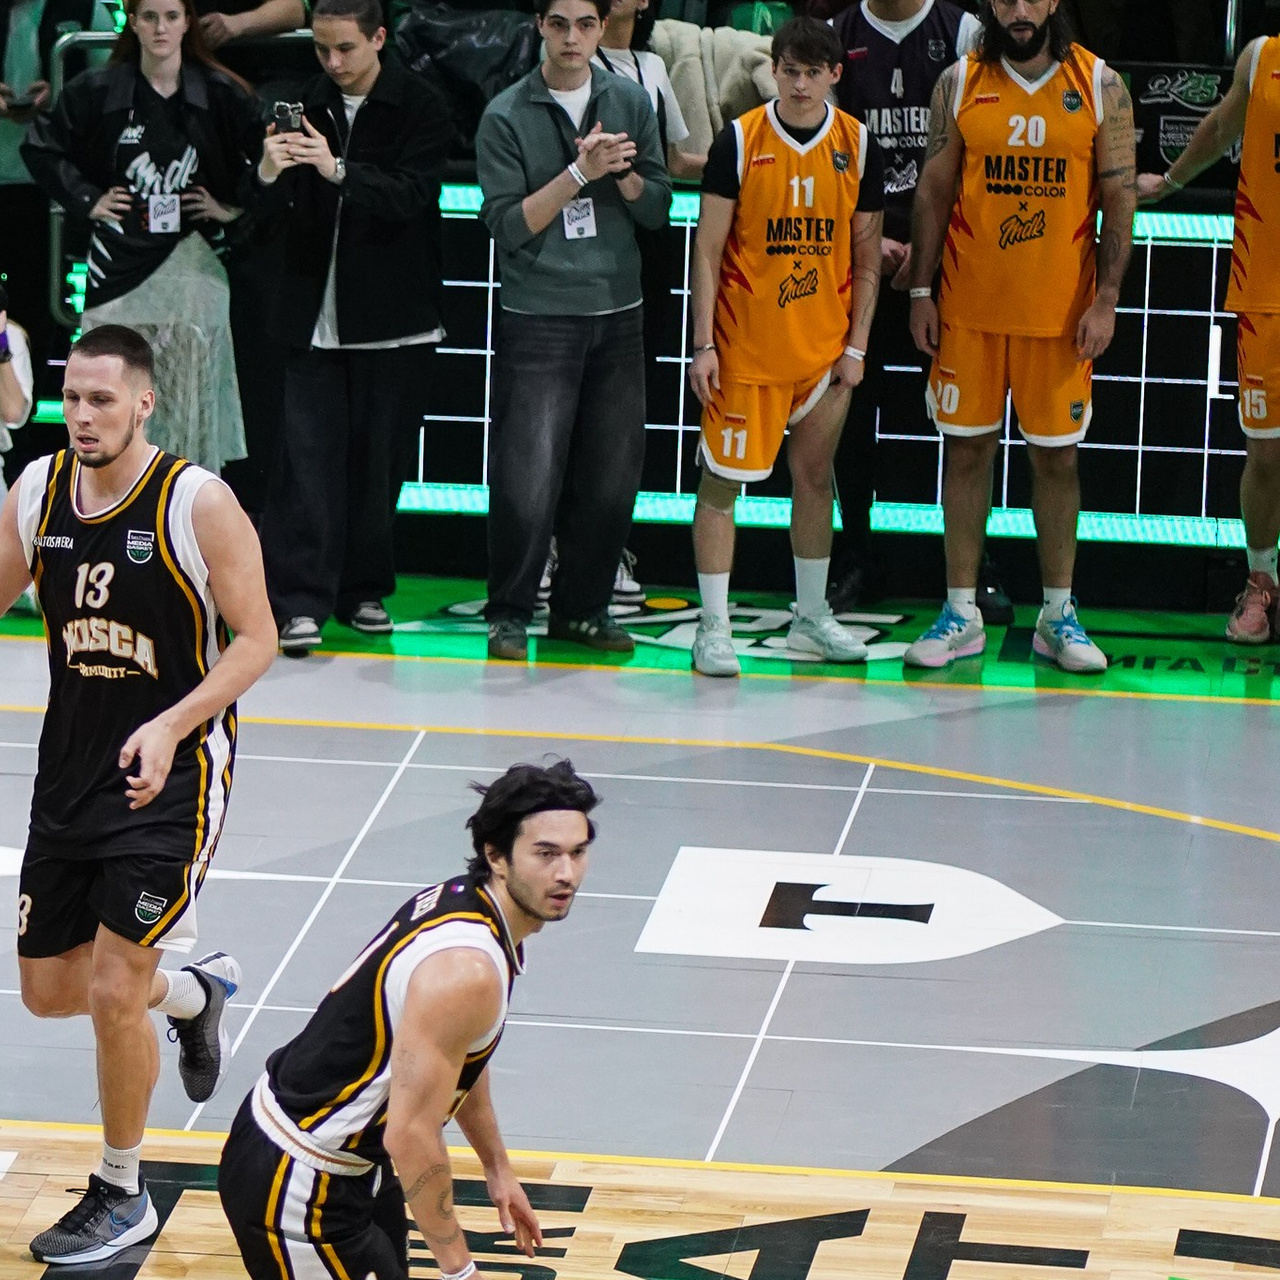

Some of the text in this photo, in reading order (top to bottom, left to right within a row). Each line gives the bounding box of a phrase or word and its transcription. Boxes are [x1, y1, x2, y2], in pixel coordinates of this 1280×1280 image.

[891, 67, 905, 99] 4
[1007, 115, 1047, 148] 20
[984, 155, 1067, 183] MASTER
[789, 175, 815, 208] 11
[1024, 185, 1066, 198] COLOR
[766, 217, 835, 244] MASTER
[1243, 389, 1268, 419] 15
[721, 427, 748, 460] 11
[74, 561, 115, 609] 13
